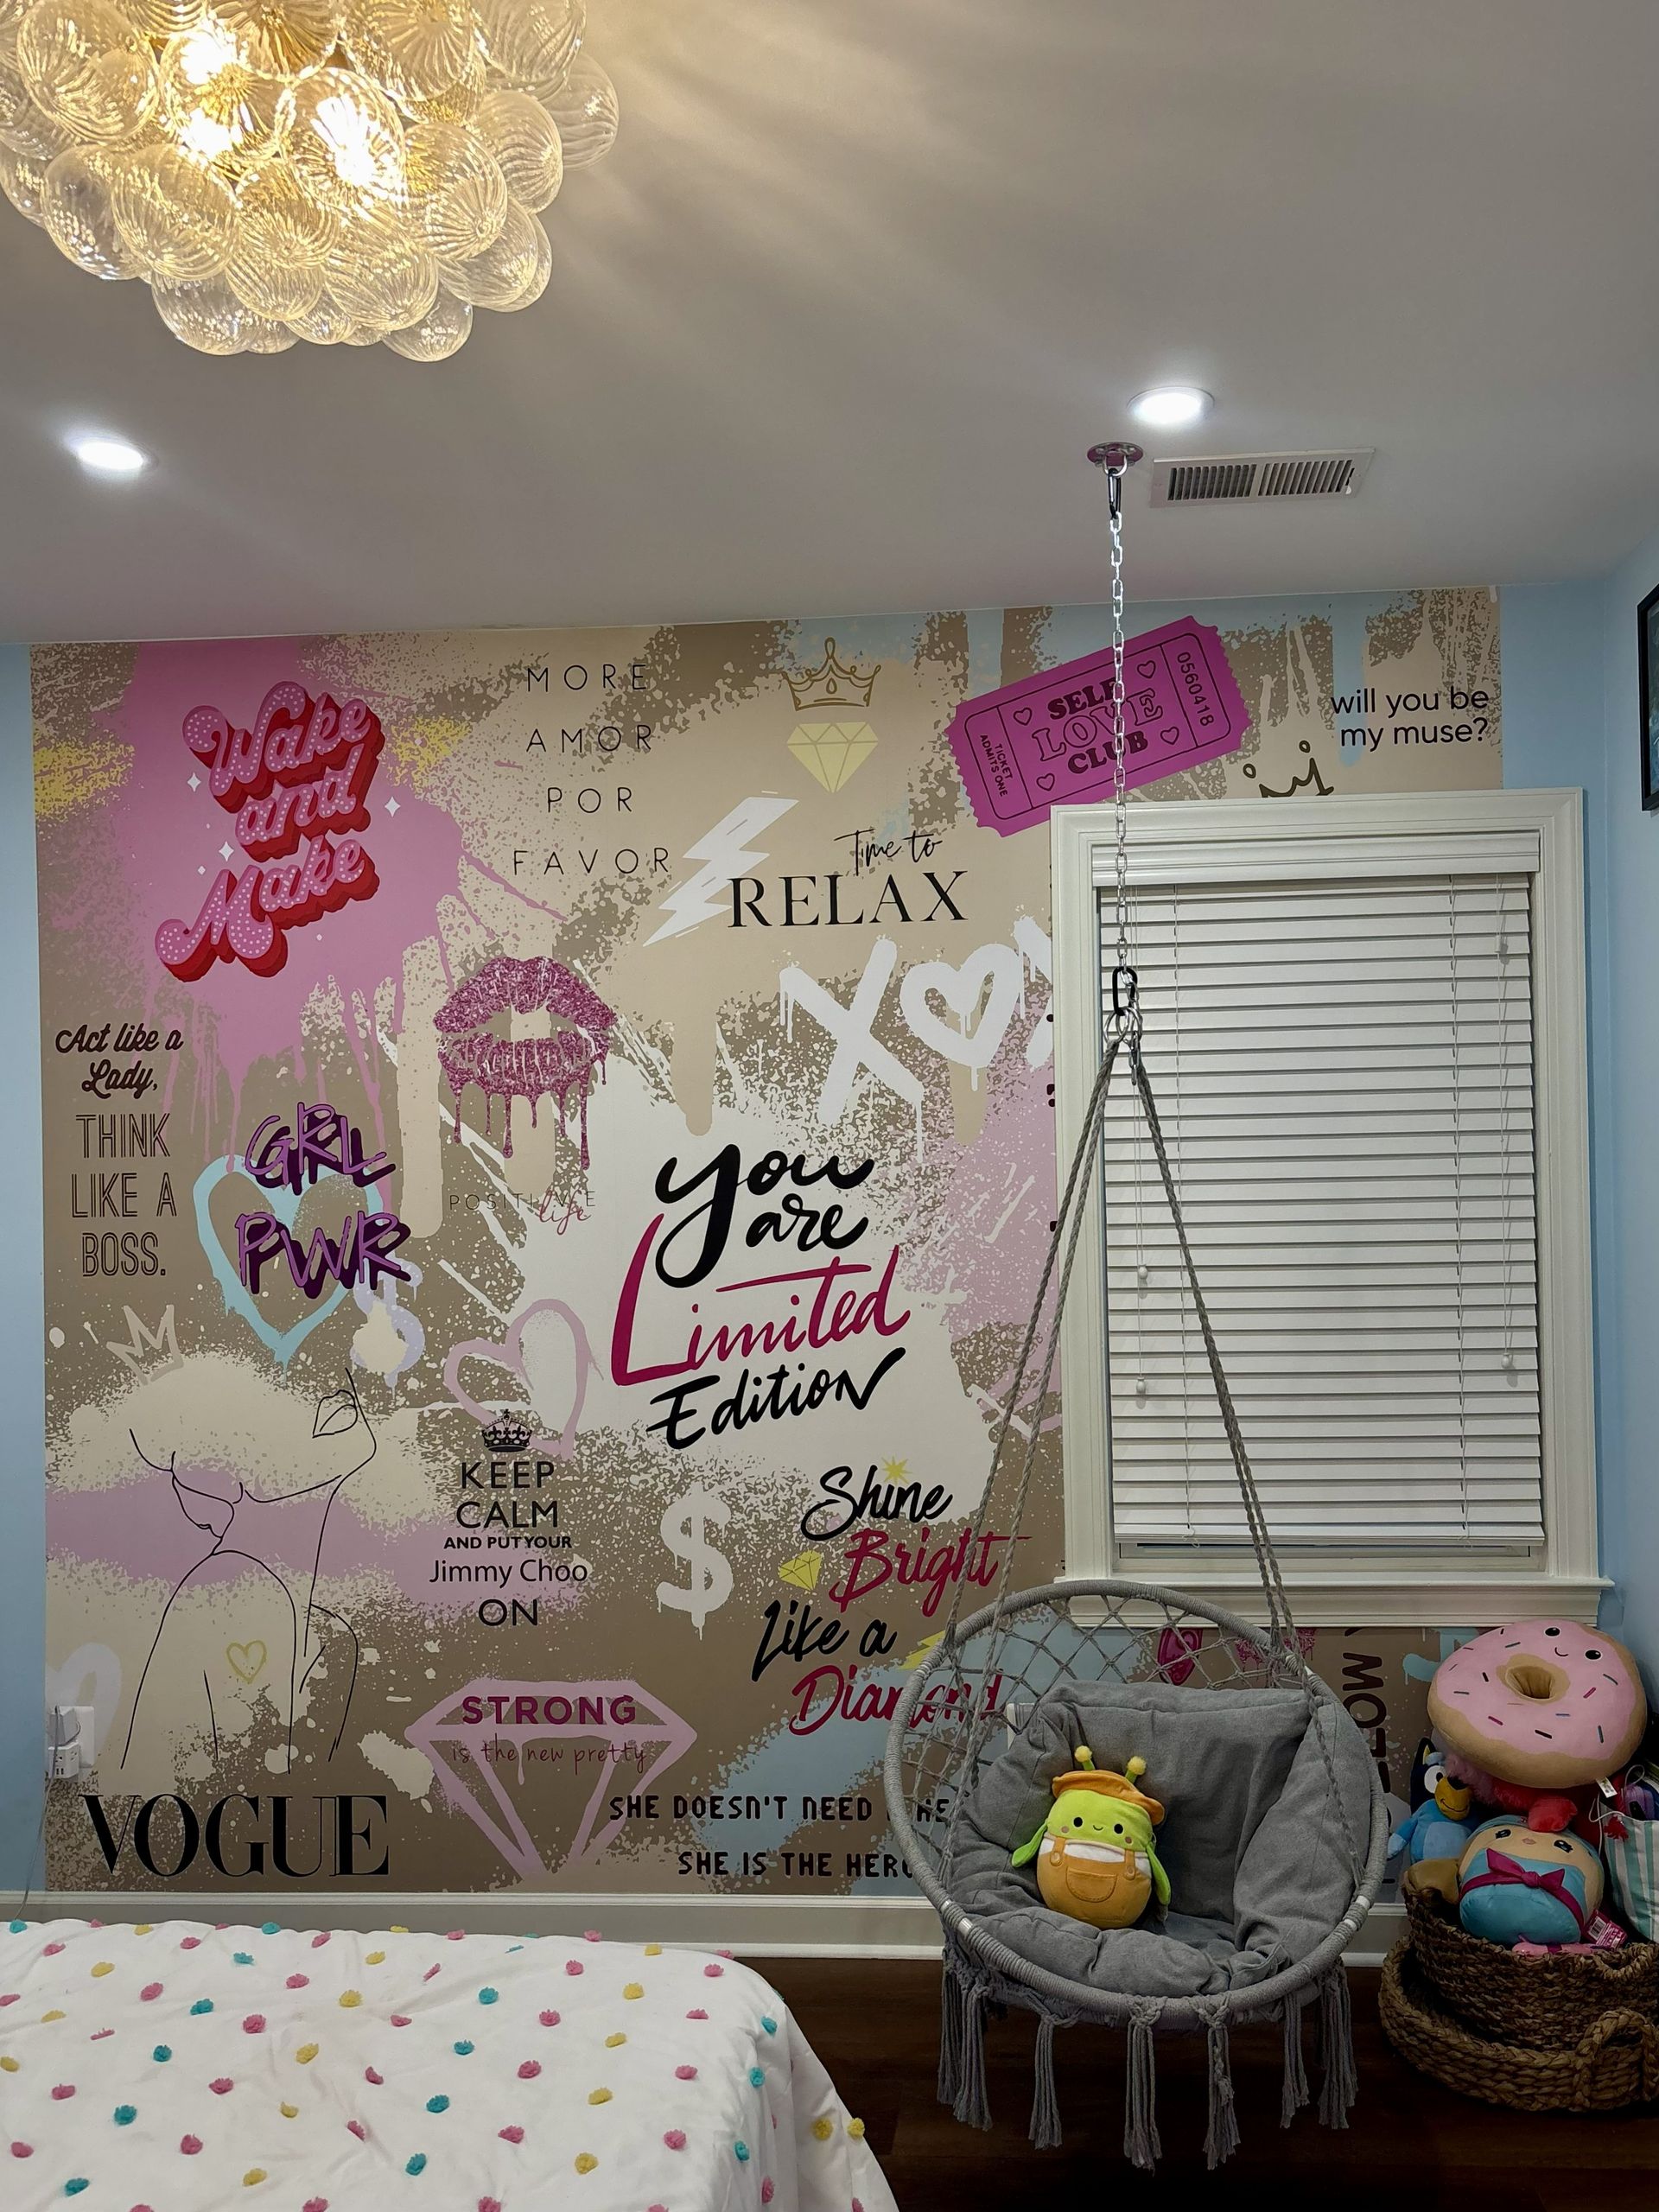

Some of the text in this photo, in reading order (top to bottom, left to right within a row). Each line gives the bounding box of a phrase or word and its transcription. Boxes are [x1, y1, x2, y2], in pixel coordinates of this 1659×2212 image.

[527, 664, 646, 692] MORE
[1048, 677, 1123, 720] SELF
[1178, 652, 1214, 726] 0560418
[1032, 688, 1163, 761] LOVE
[1331, 686, 1489, 718] will you be
[182, 681, 385, 813] Wake
[526, 724, 652, 753] AMOR
[1068, 731, 1148, 774] CLUB
[1340, 716, 1489, 753] my muse?
[980, 734, 1008, 797] ADMITS ONE
[995, 743, 1013, 779] TICKET
[235, 745, 379, 862] and
[547, 787, 632, 813] POR
[513, 848, 669, 874] FAVOR
[833, 828, 942, 875] Time to
[156, 836, 379, 982] Make
[727, 870, 968, 927] RELAX
[55, 1023, 184, 1053] Act like a
[81, 1059, 158, 1099] Lady,
[75, 1113, 170, 1158] THINK
[245, 1102, 396, 1195] GRL
[71, 1172, 177, 1217] LIKE A
[539, 1186, 591, 1236] life
[745, 1193, 868, 1251] are
[82, 1231, 166, 1277] BOSS.
[236, 1211, 411, 1299] PWR
[611, 1213, 911, 1386] Limited
[645, 1347, 906, 1450] Edition
[461, 1461, 554, 1489] KEEP
[455, 1500, 557, 1529] CALM
[800, 1464, 953, 1541] Shine
[444, 1536, 572, 1549] AND PUT YOUR
[429, 1559, 588, 1589] Jimmy Choo
[829, 1526, 1033, 1618] Bright
[478, 1599, 538, 1626] ON
[751, 1599, 898, 1682] Like a
[462, 1695, 636, 1725] STRONG
[453, 1733, 646, 1775] is the new pretty
[609, 1796, 659, 1821] SHE
[803, 1796, 872, 1821] NEED
[78, 1794, 390, 1877] VOGUE
[678, 1851, 728, 1877] SHE
[743, 1852, 766, 1877] IS
[780, 1852, 832, 1878] THE
